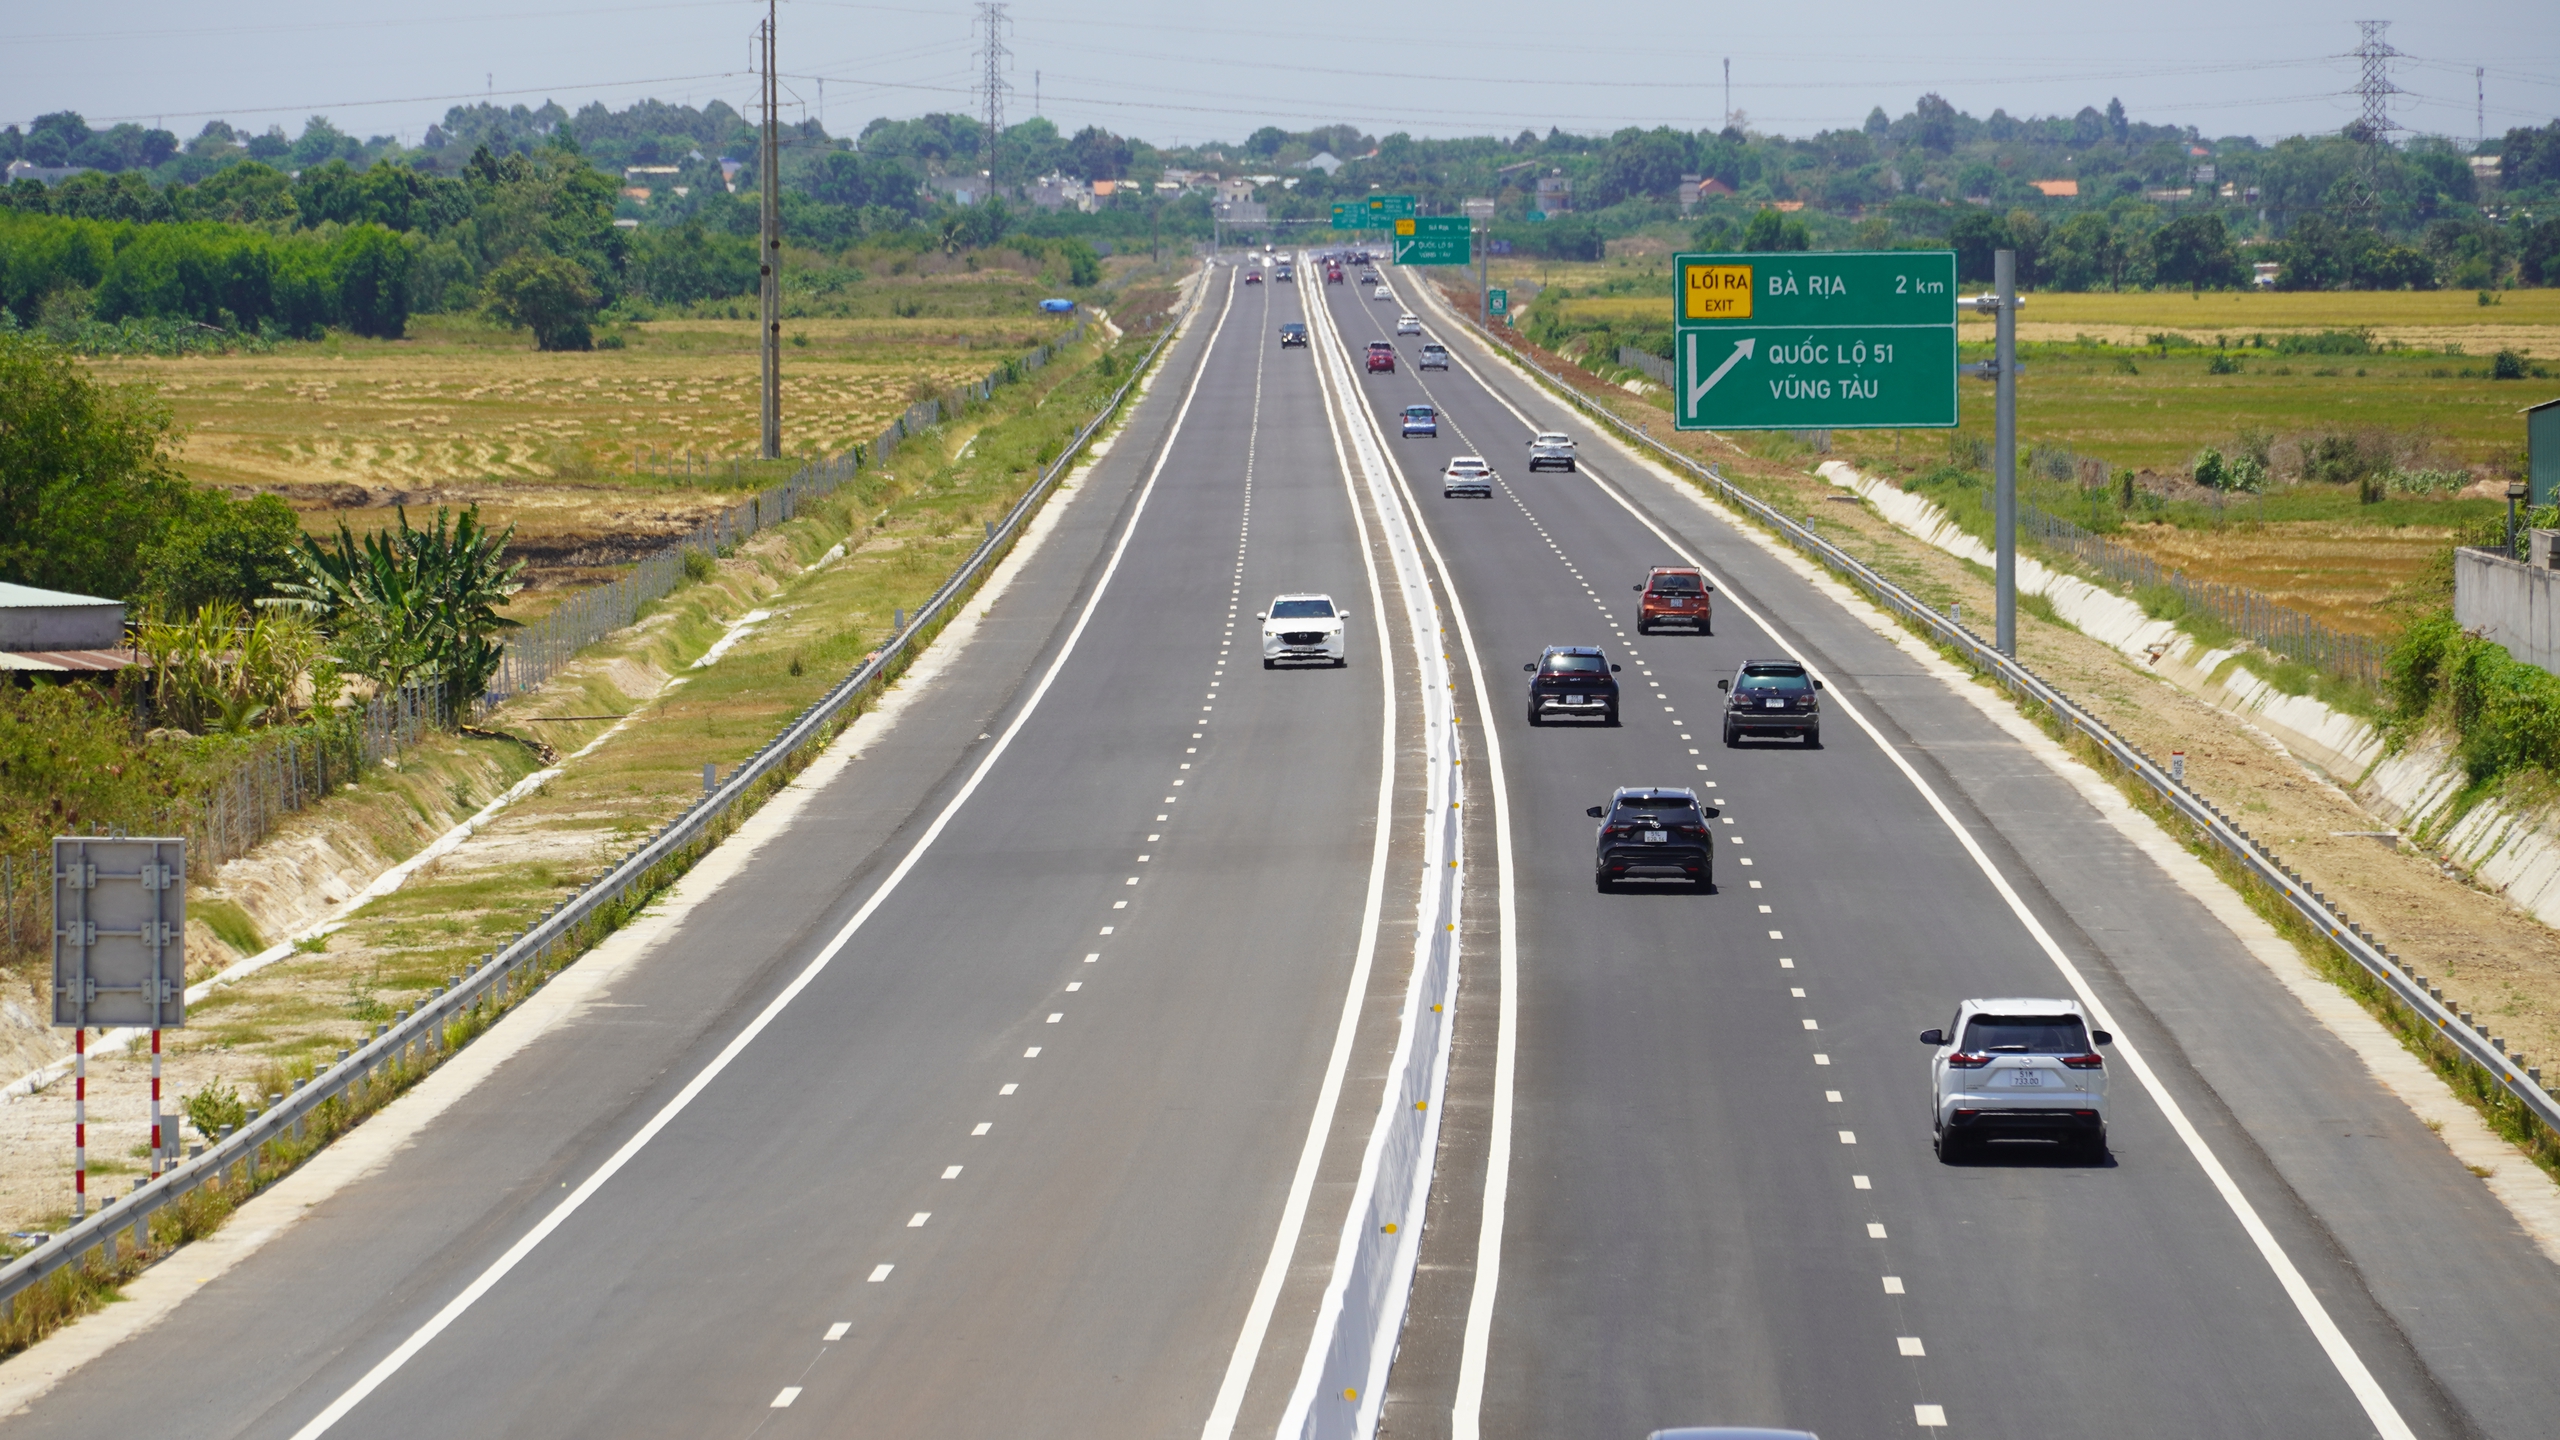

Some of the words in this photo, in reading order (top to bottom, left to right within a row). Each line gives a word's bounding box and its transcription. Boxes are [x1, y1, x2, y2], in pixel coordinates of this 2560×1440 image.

[1691, 268, 1719, 290] LỐI
[1724, 274, 1748, 290] RA
[1768, 270, 1799, 296] BÀ
[1808, 275, 1847, 300] RỊA
[1895, 275, 1907, 294] 2
[1916, 277, 1944, 294] km
[1705, 299, 1734, 312] EXIT
[1769, 335, 1829, 365] QUỐC
[1837, 339, 1867, 368] LỘ
[1873, 344, 1893, 364] 51
[1769, 374, 1831, 400] VŨNG
[1838, 374, 1878, 400] TÀU
[2014, 1077, 2039, 1085] 733.00
